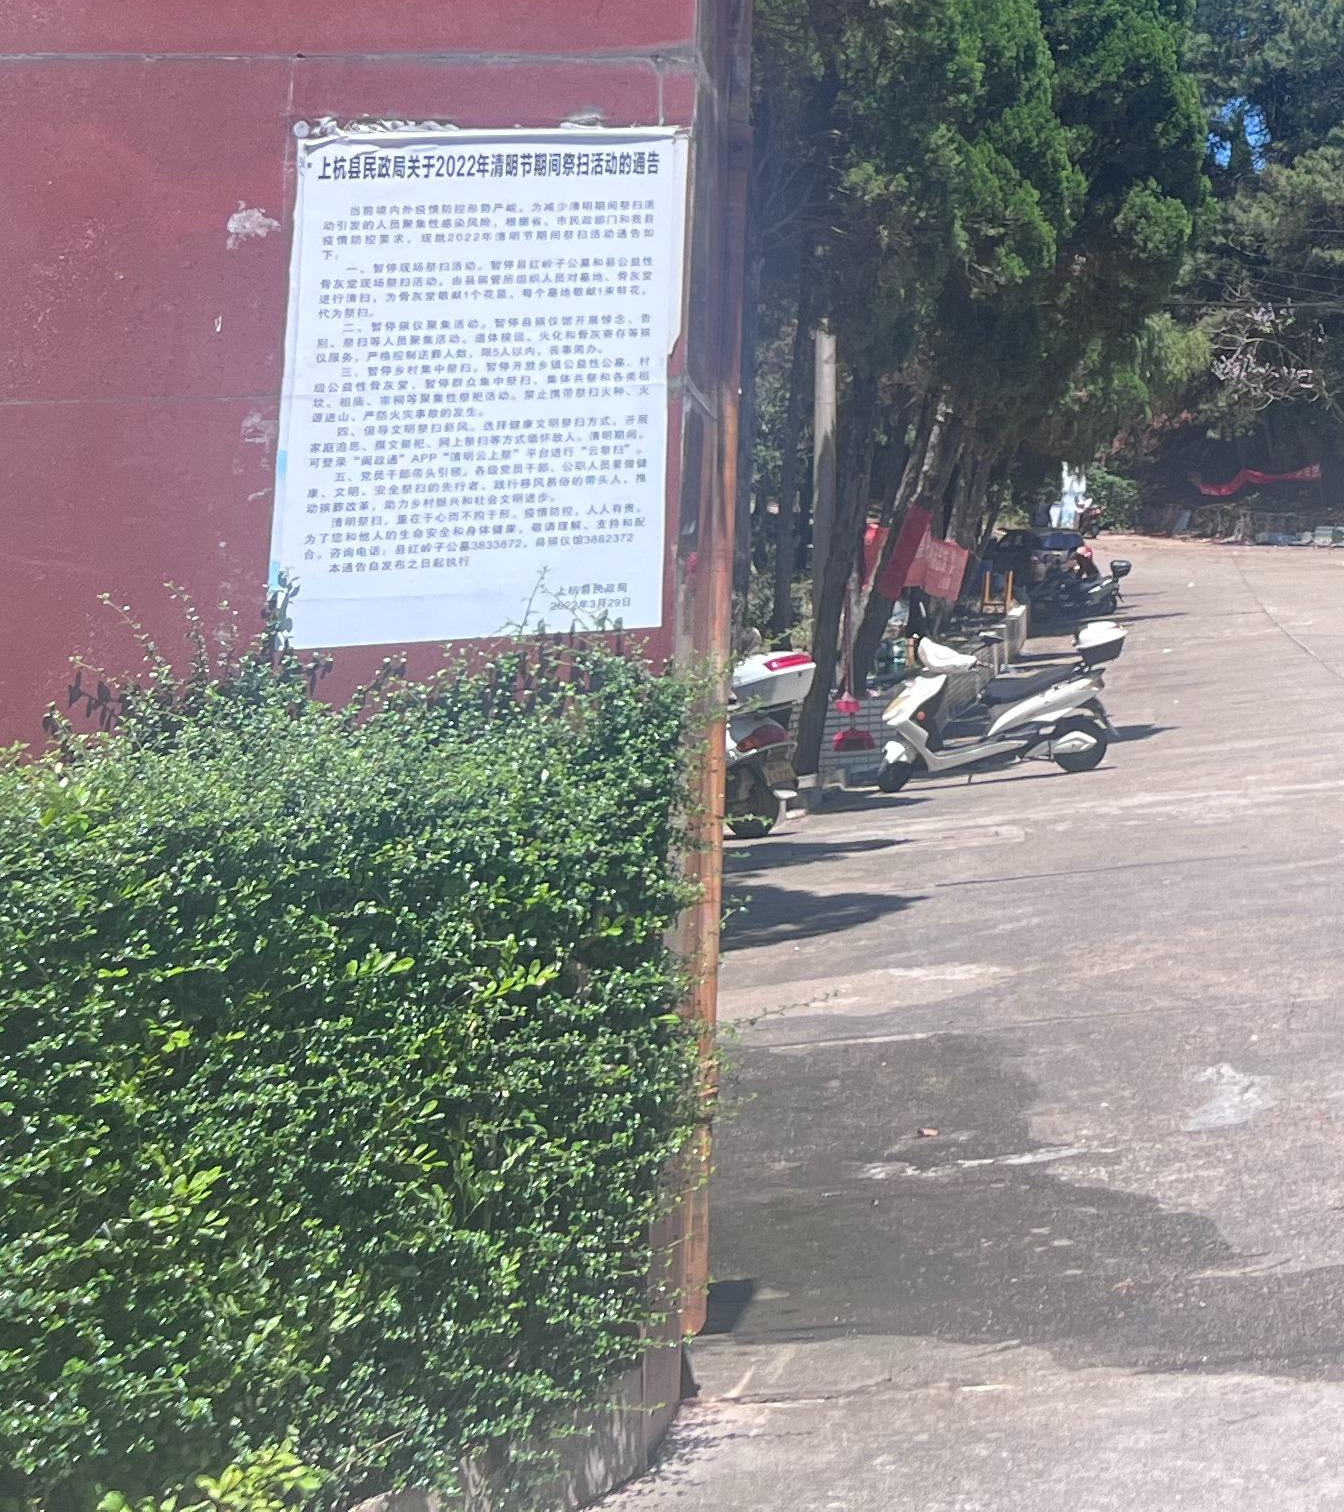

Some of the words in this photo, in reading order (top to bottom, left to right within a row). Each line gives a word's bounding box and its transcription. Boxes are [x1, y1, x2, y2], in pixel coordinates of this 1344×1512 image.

[318, 151, 660, 180] 上杭县民政局关于2022年清明节期间祭扫活动的通告
